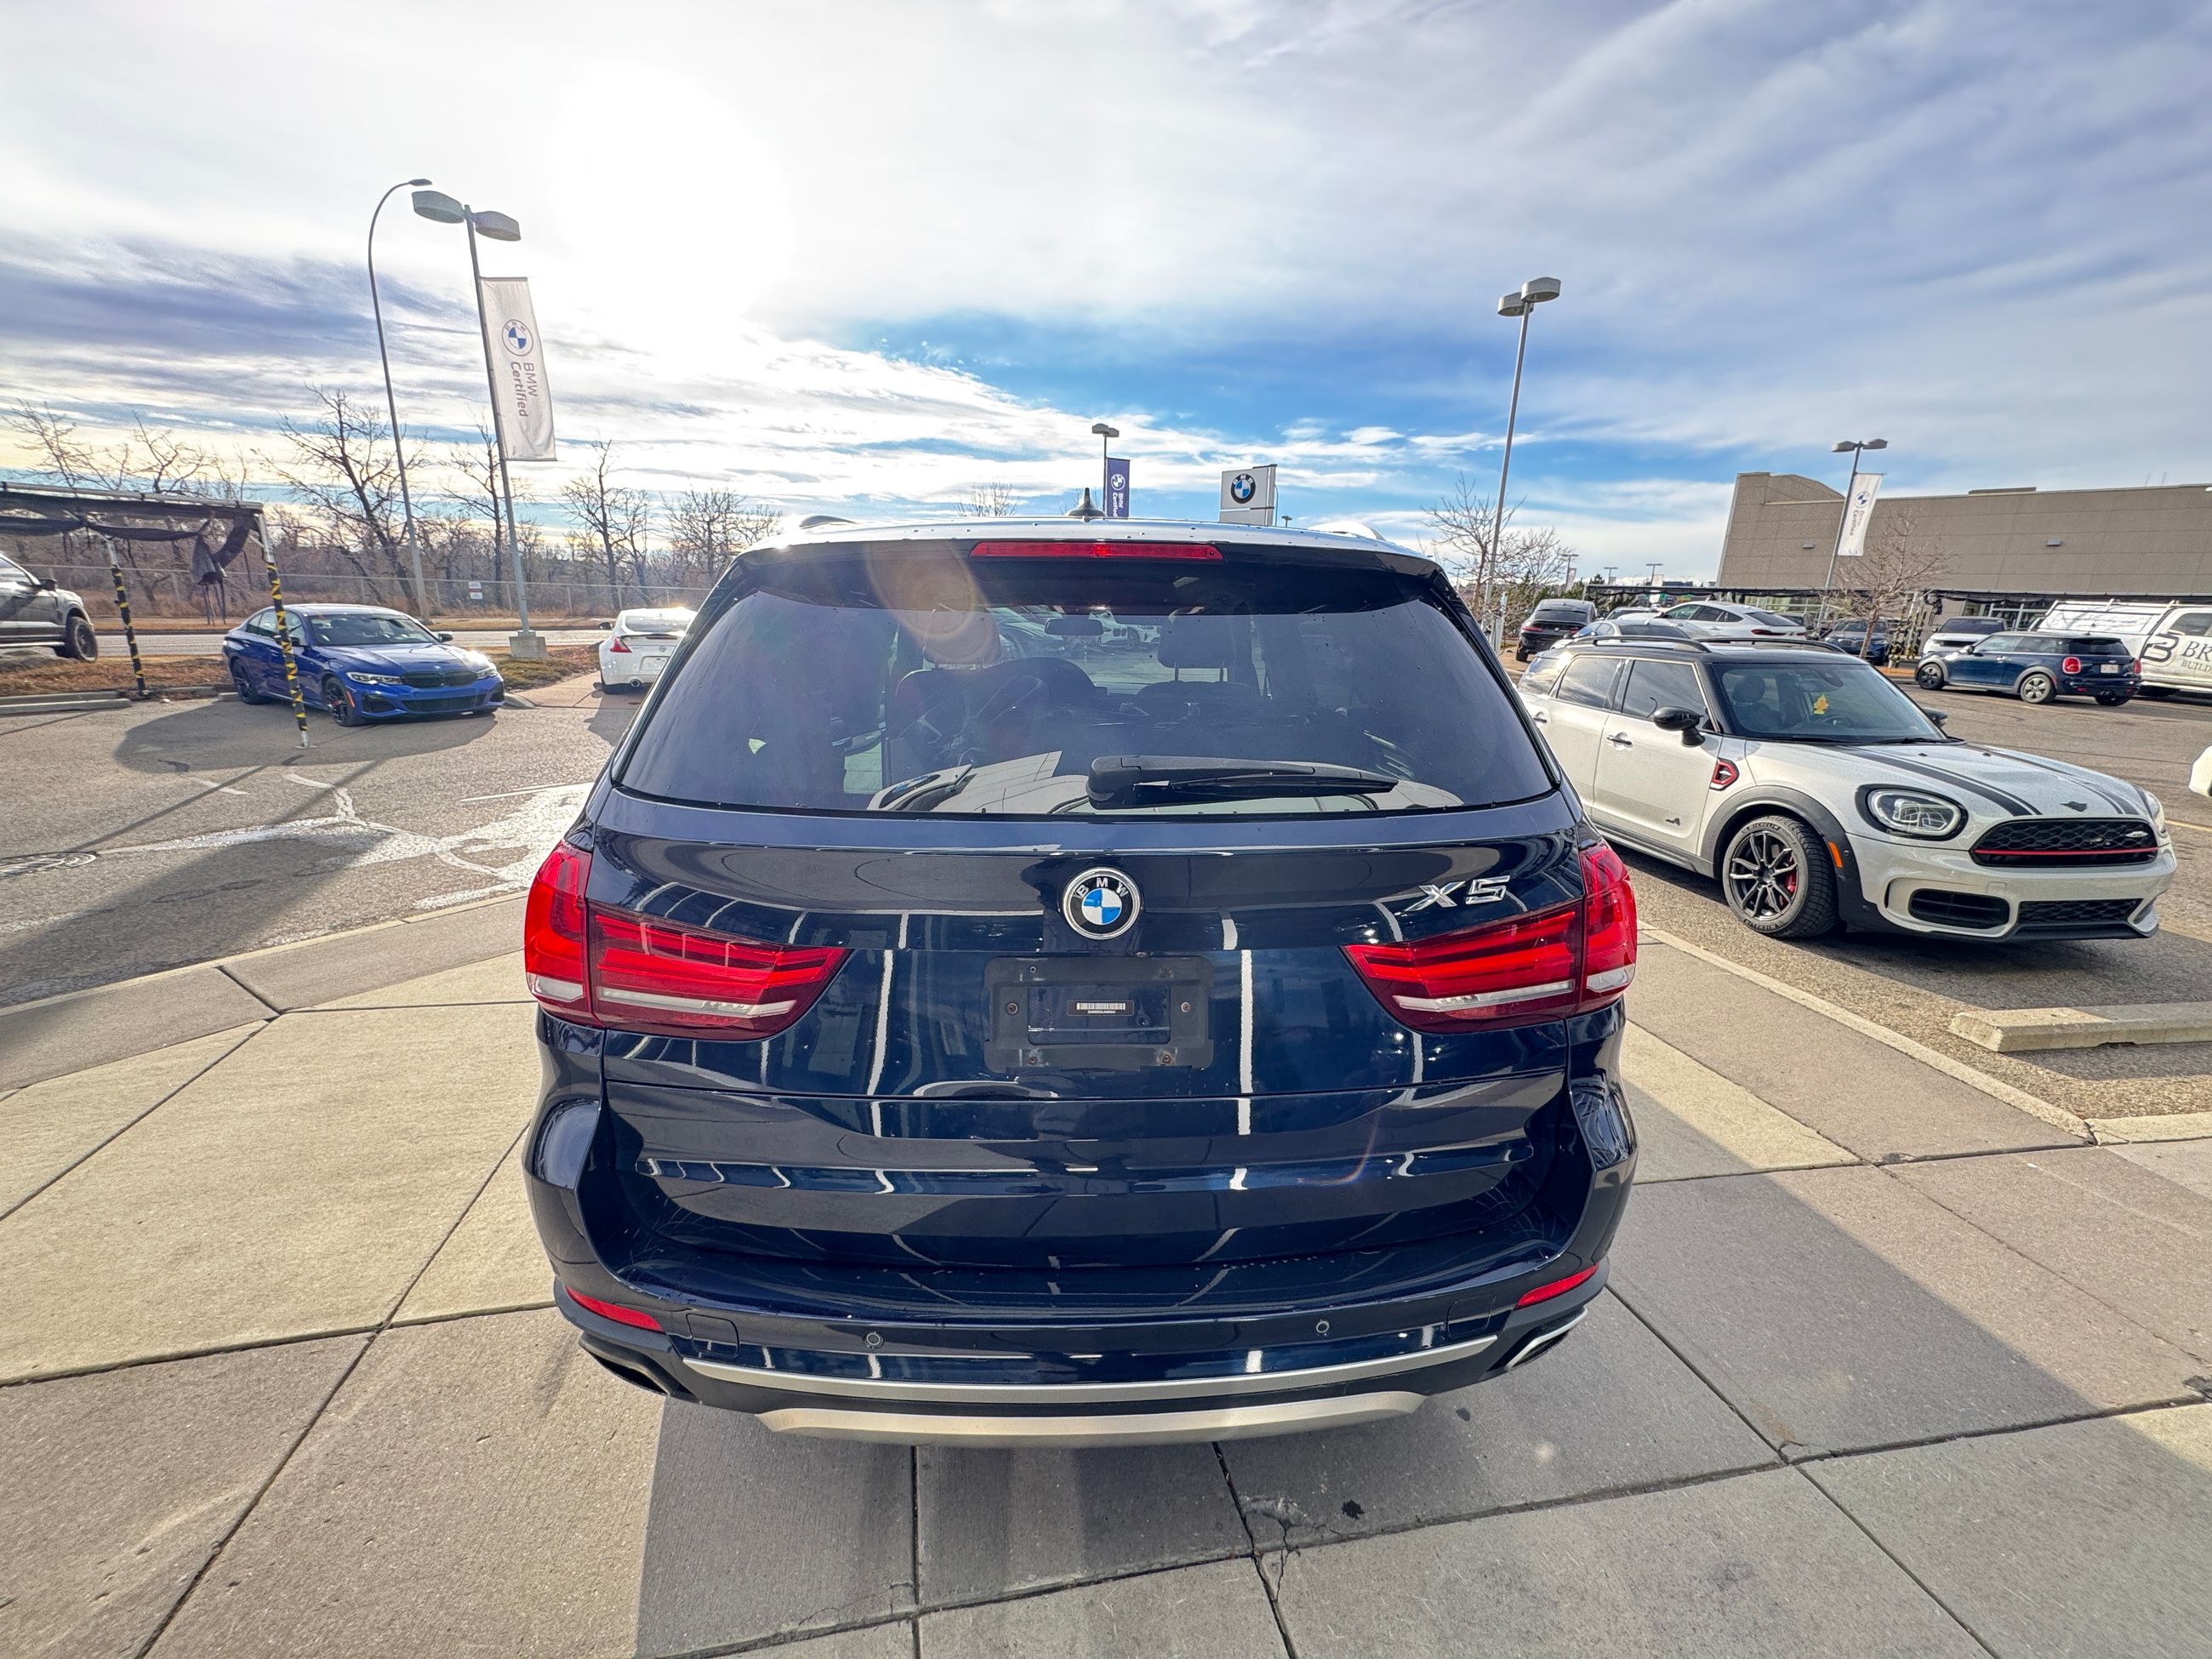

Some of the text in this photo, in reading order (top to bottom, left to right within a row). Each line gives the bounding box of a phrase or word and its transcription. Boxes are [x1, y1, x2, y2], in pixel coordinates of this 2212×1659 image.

[510, 362, 528, 417] Certified
[523, 362, 539, 396] BMW
[1075, 877, 1129, 899] BMW
[1405, 875, 1511, 912] X5
